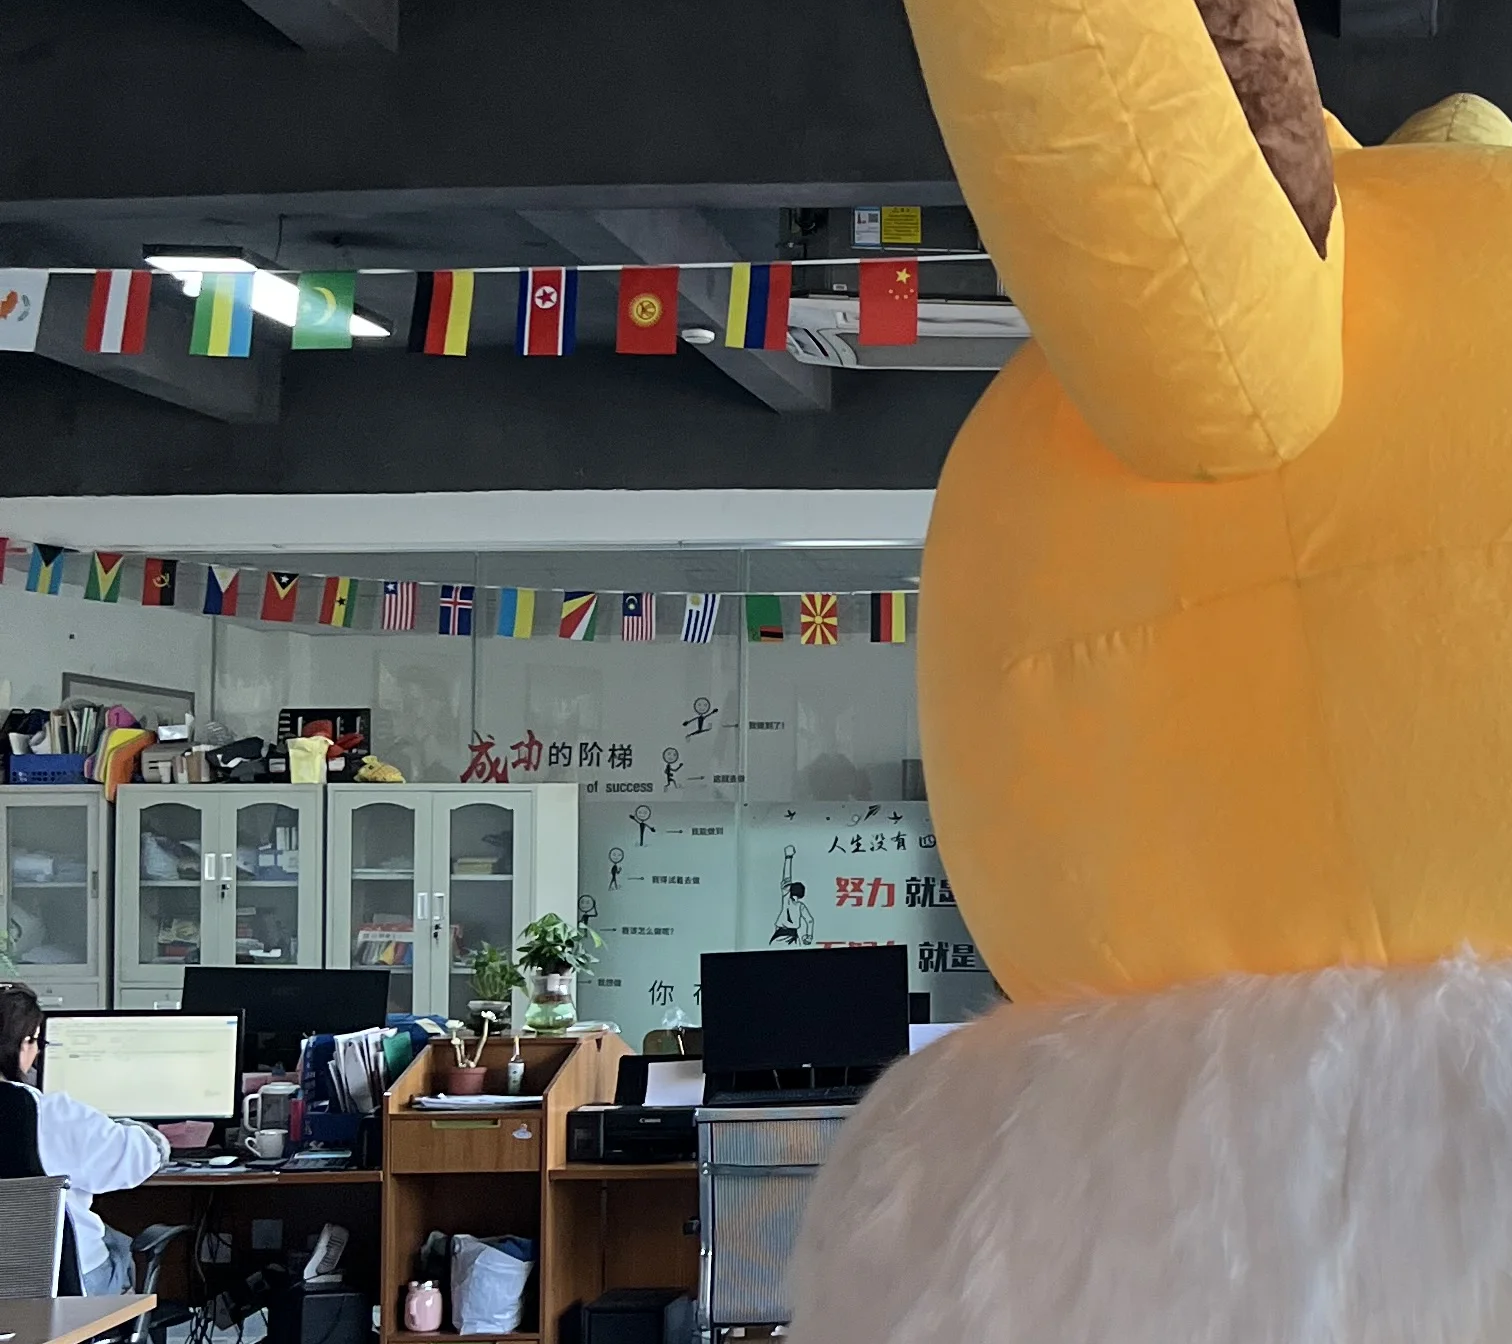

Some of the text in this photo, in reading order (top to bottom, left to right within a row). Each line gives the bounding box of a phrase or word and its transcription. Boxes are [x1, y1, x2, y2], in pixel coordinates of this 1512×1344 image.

[460, 729, 633, 783] 成功的阶梯
[586, 781, 653, 793] of success
